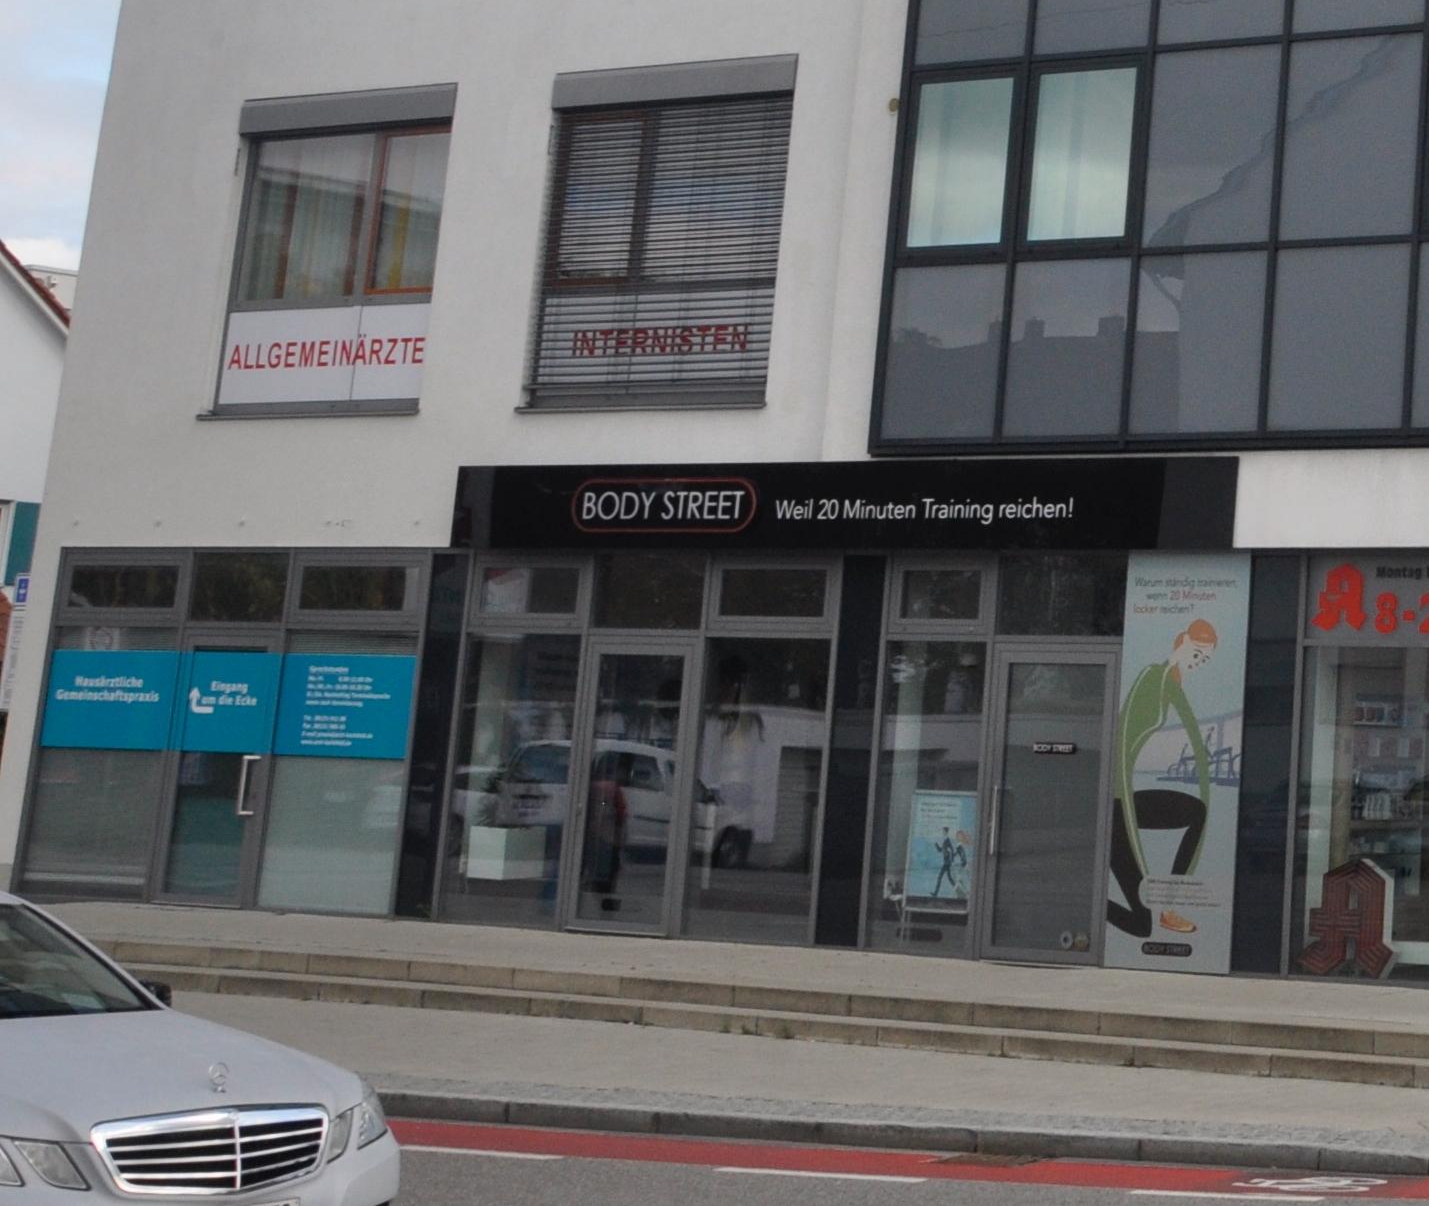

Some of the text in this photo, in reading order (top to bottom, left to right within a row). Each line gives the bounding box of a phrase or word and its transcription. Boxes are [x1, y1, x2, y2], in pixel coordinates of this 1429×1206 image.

[571, 324, 749, 358] INTERNISTEN
[228, 334, 427, 371] ALLGEMEINÄRZTE
[582, 490, 745, 521] BODY STREET
[775, 496, 1075, 526] Weil 20 Minuten Training reichen!
[1375, 566, 1422, 580] Montag
[74, 675, 144, 689] Hausärztliche
[210, 680, 249, 694] Eingang
[55, 689, 160, 704] Gemeinschaftspraxis
[218, 695, 234, 706] die
[235, 695, 258, 707] Ecke
